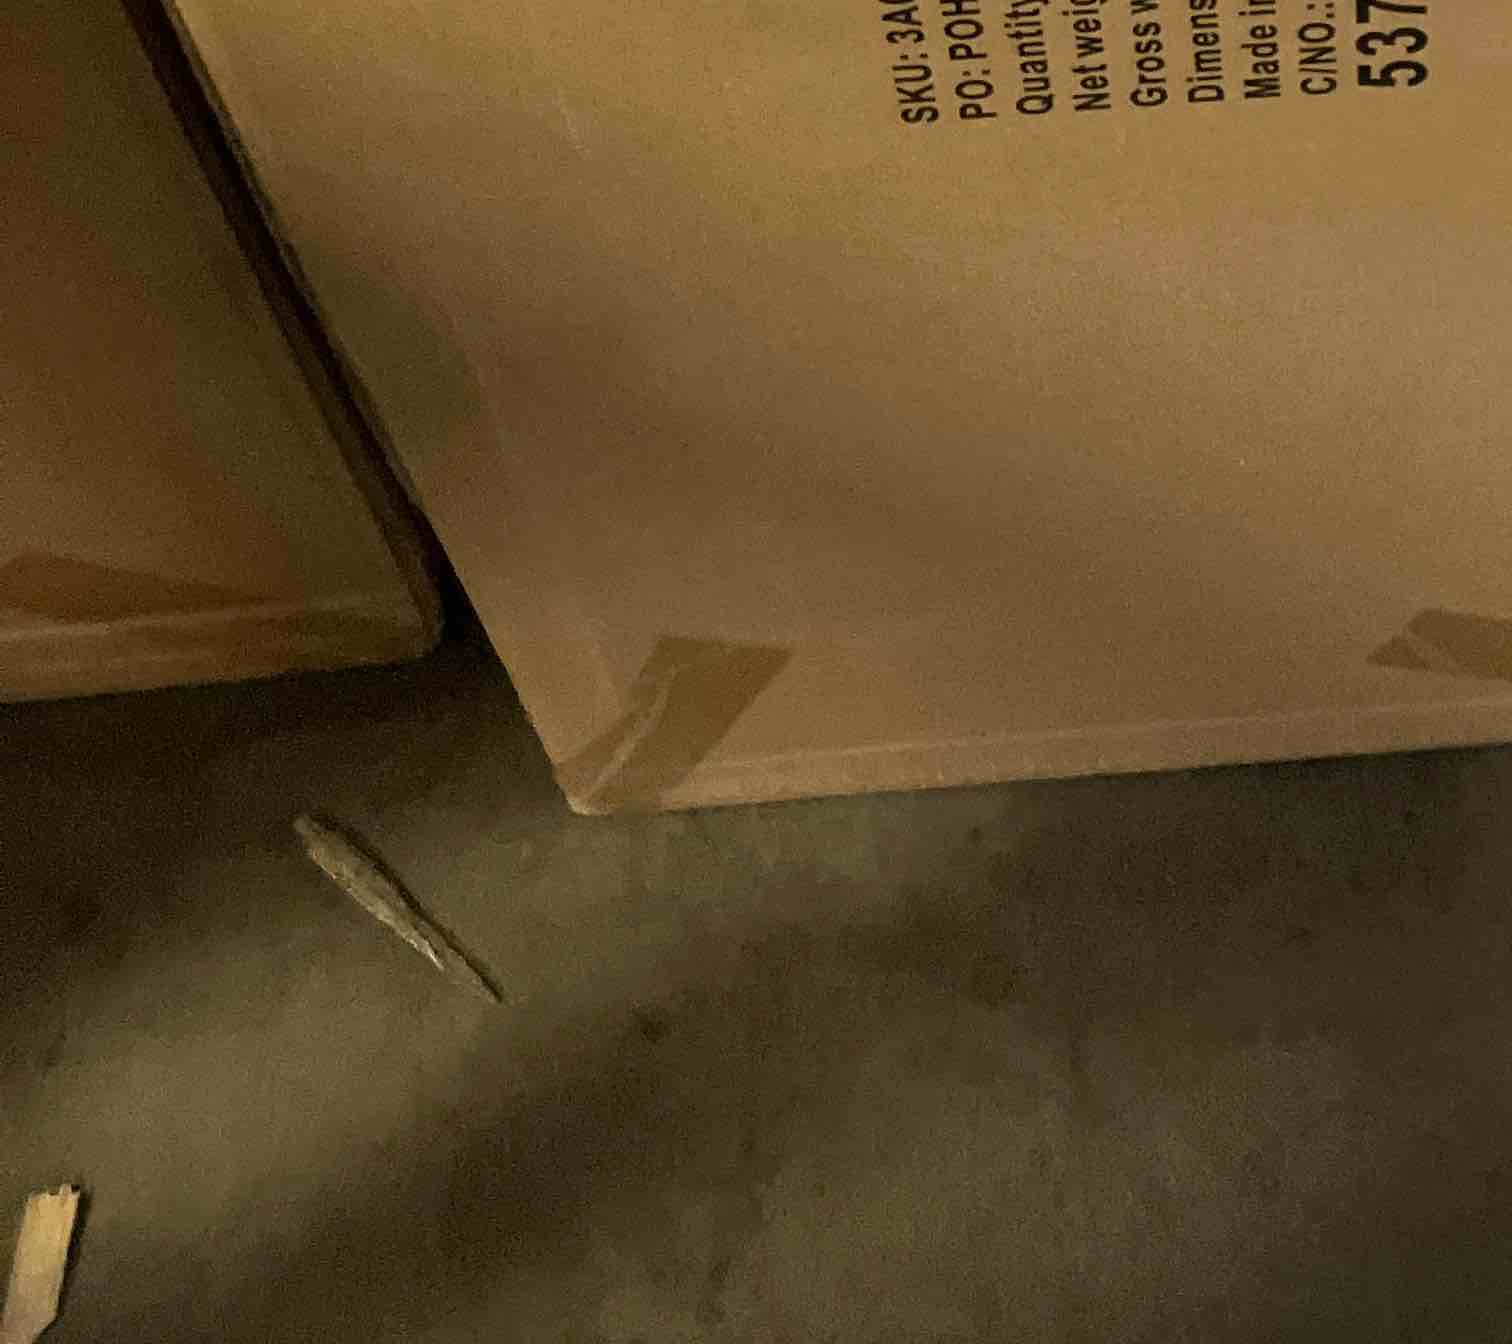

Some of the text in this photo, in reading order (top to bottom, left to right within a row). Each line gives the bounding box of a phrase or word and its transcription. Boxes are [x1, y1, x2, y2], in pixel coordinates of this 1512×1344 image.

[1130, 21, 1168, 107] Gross
[1241, 24, 1281, 99] Made
[1298, 1, 1338, 96] C/NO.:
[892, 52, 939, 124] SKU:
[955, 66, 998, 120] PO:
[1070, 61, 1111, 112] Net
